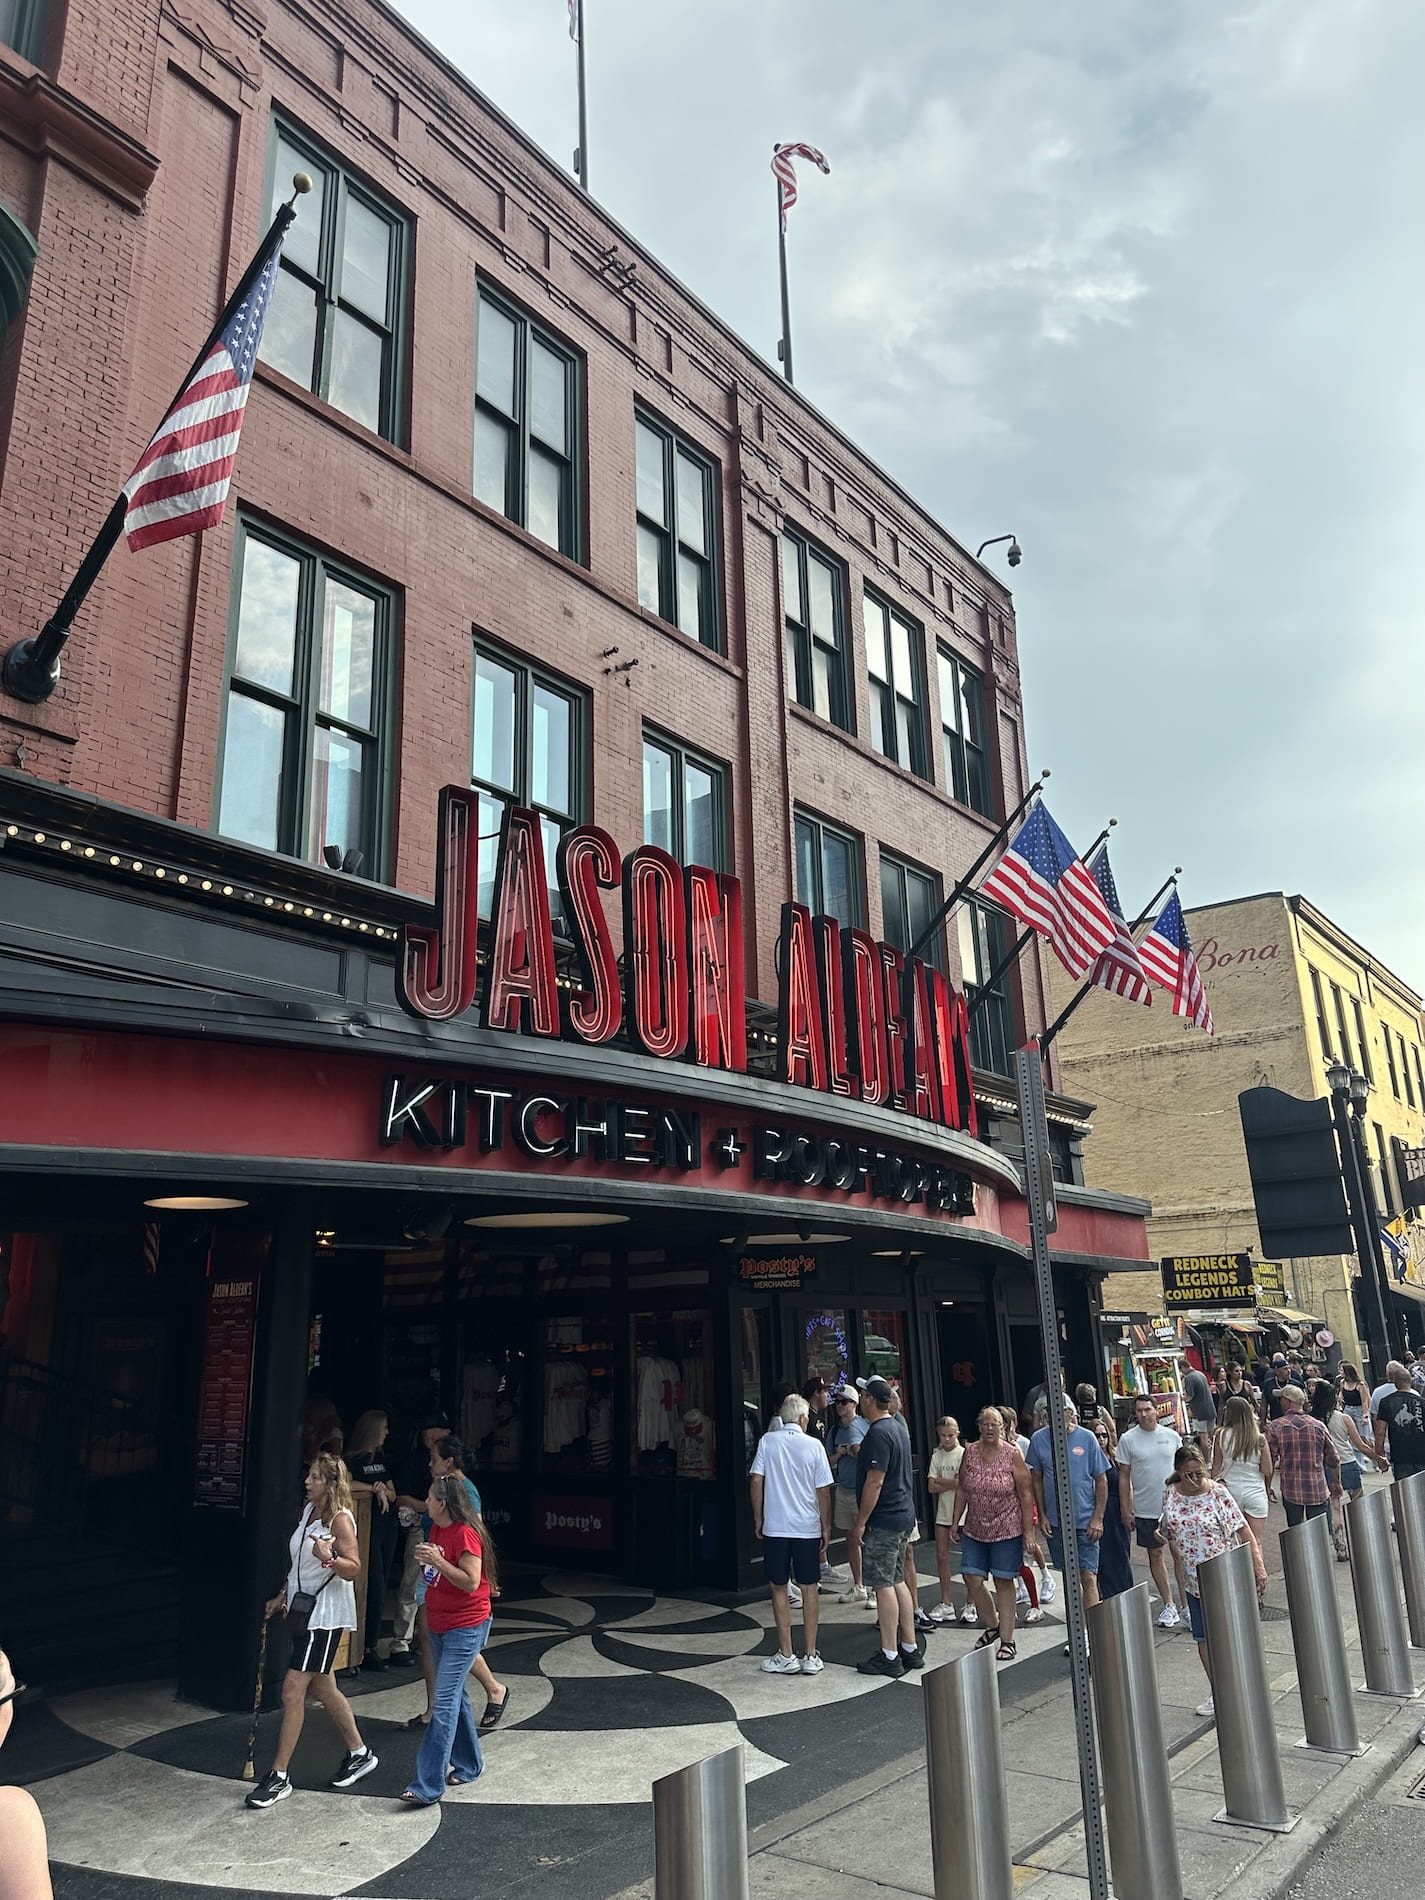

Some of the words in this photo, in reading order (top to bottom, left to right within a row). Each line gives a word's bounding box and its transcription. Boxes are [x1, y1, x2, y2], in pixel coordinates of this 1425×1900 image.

[395, 784, 747, 1073] JASON
[1193, 936, 1281, 973] Bona
[383, 1075, 701, 1171] KITCHEN
[740, 1254, 816, 1279] Posty's
[1173, 1256, 1239, 1271] REDNECK
[753, 1279, 801, 1289] MERCHANDISE
[1175, 1271, 1238, 1287] LEGENDS
[1165, 1287, 1220, 1301] COWBOY
[1222, 1284, 1256, 1298] HATS
[545, 1511, 602, 1533] Posty's
